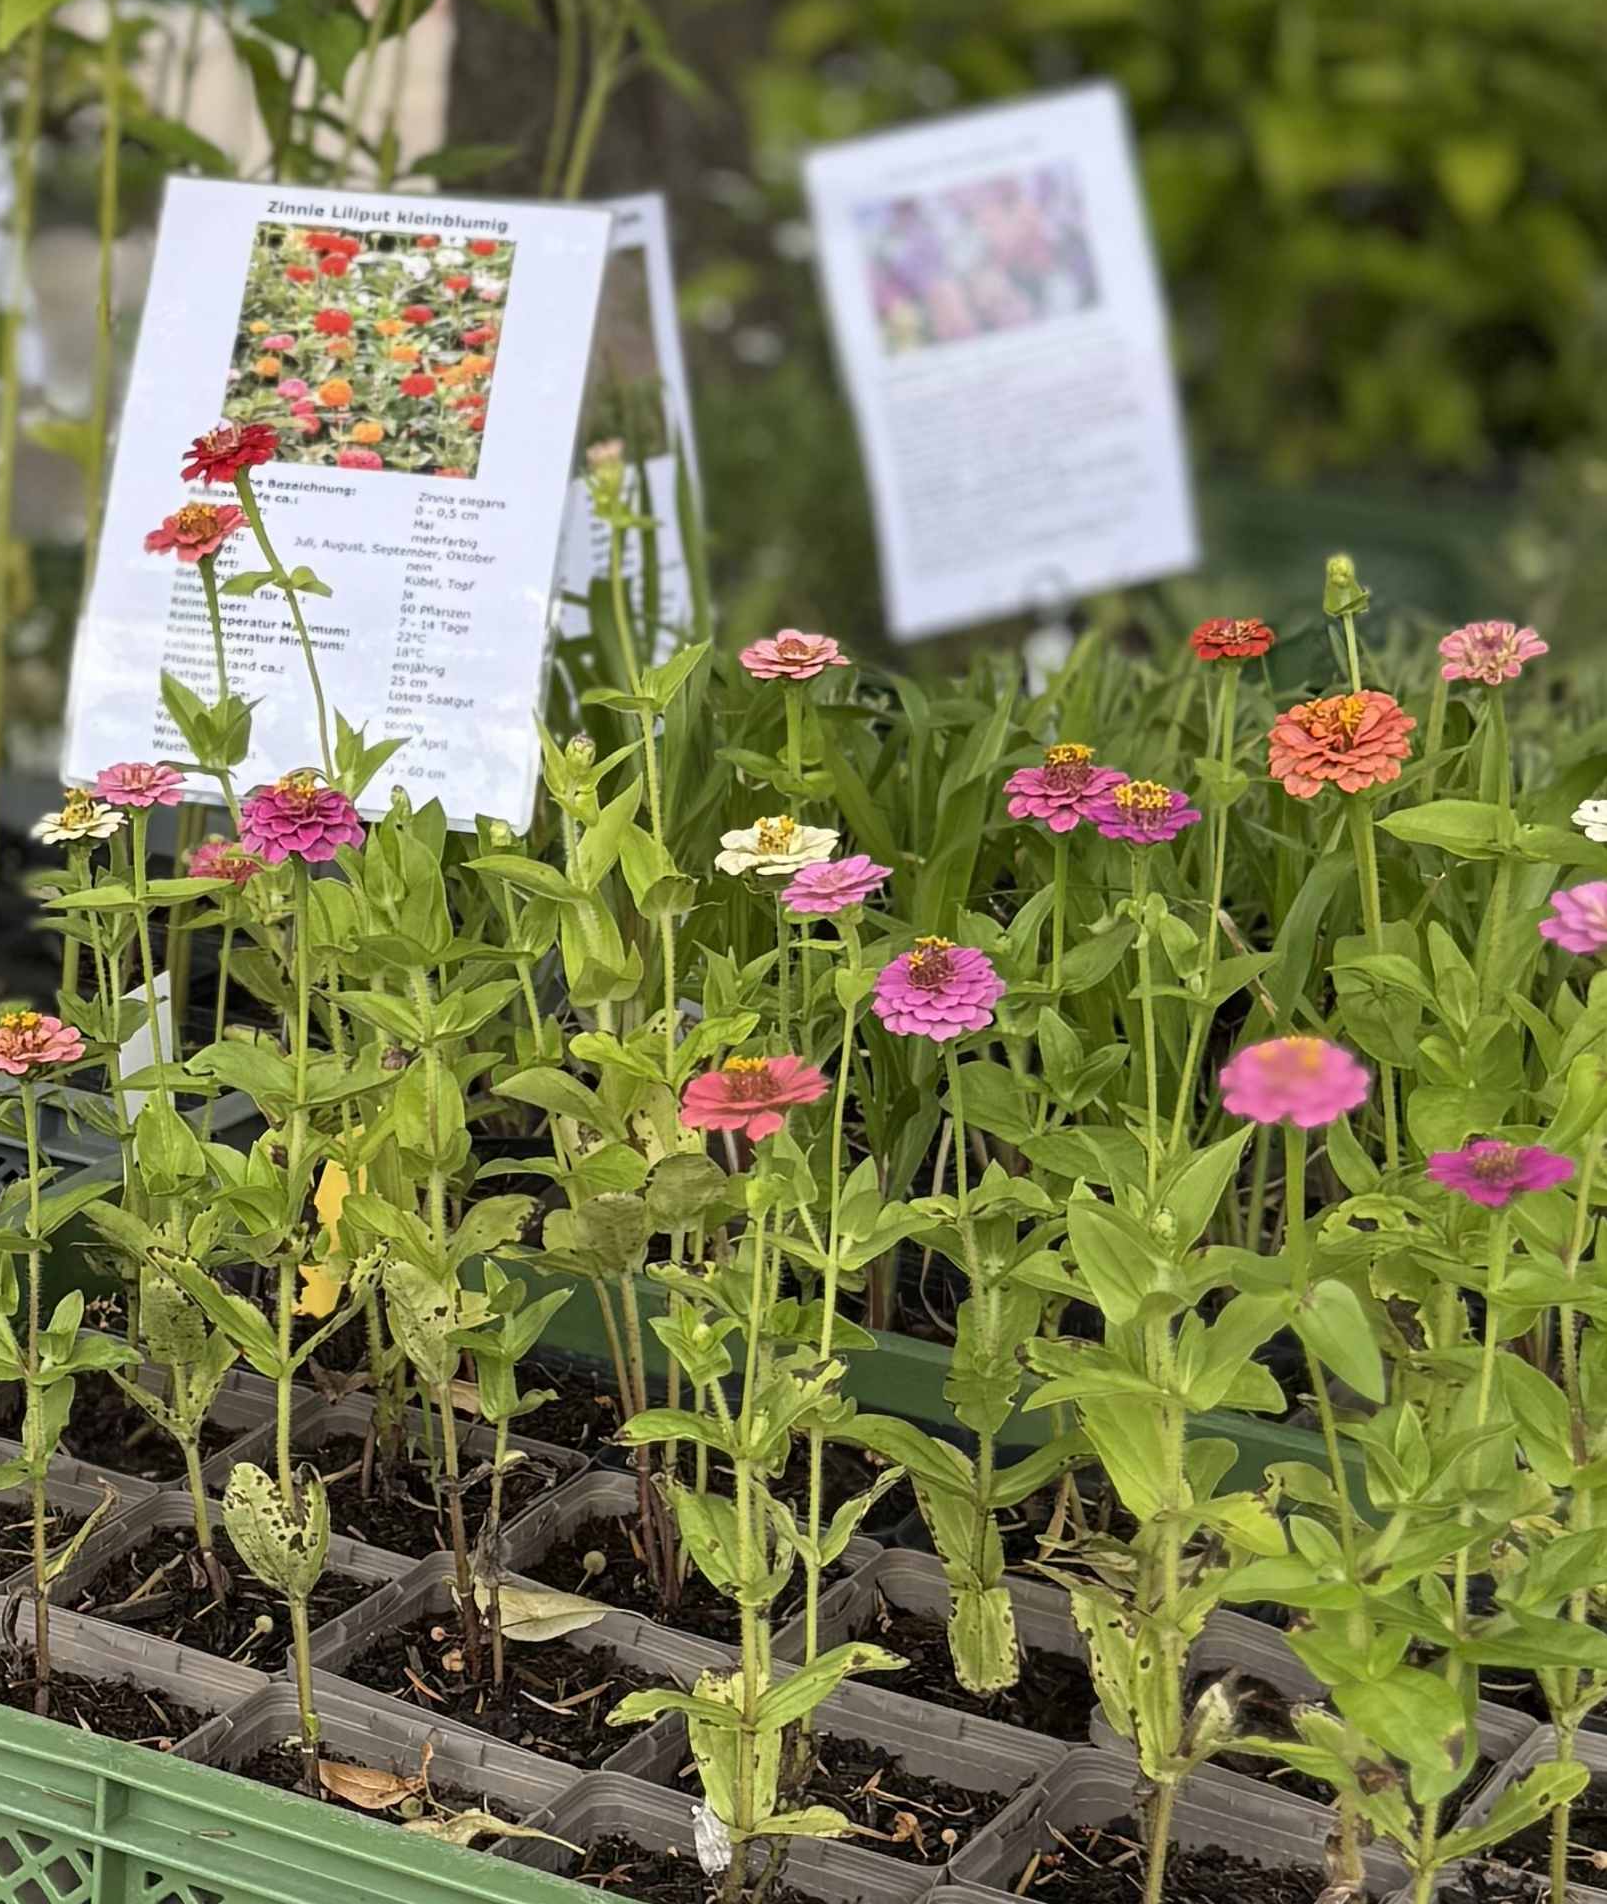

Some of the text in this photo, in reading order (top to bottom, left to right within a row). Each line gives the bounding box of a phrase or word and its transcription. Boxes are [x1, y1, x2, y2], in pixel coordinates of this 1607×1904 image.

[266, 200, 510, 234] Zinnie Liliput kleinblumig
[267, 479, 356, 497] Bezeichnung:
[418, 492, 506, 510] Zinnia elegans
[437, 508, 457, 520] 0,5
[461, 511, 479, 521] cm
[411, 533, 478, 550] mehrfarbig
[322, 538, 367, 554] August,
[372, 544, 442, 562] September,
[446, 550, 496, 565] Oktober
[406, 562, 432, 573] nein
[404, 575, 475, 591] Kübel, Topf
[171, 596, 247, 614] Keimuer:
[400, 603, 472, 620] 60 Pflanzen
[168, 609, 351, 638] Keimtperatur Mimum:
[441, 621, 469, 635] Tage
[167, 623, 346, 653] Keimteperatur Minmum:
[396, 631, 427, 644] 22°C
[395, 646, 425, 659] 18°C
[392, 662, 446, 678] einjährig
[390, 675, 428, 688] 25 cm
[427, 693, 474, 709] Saatgut
